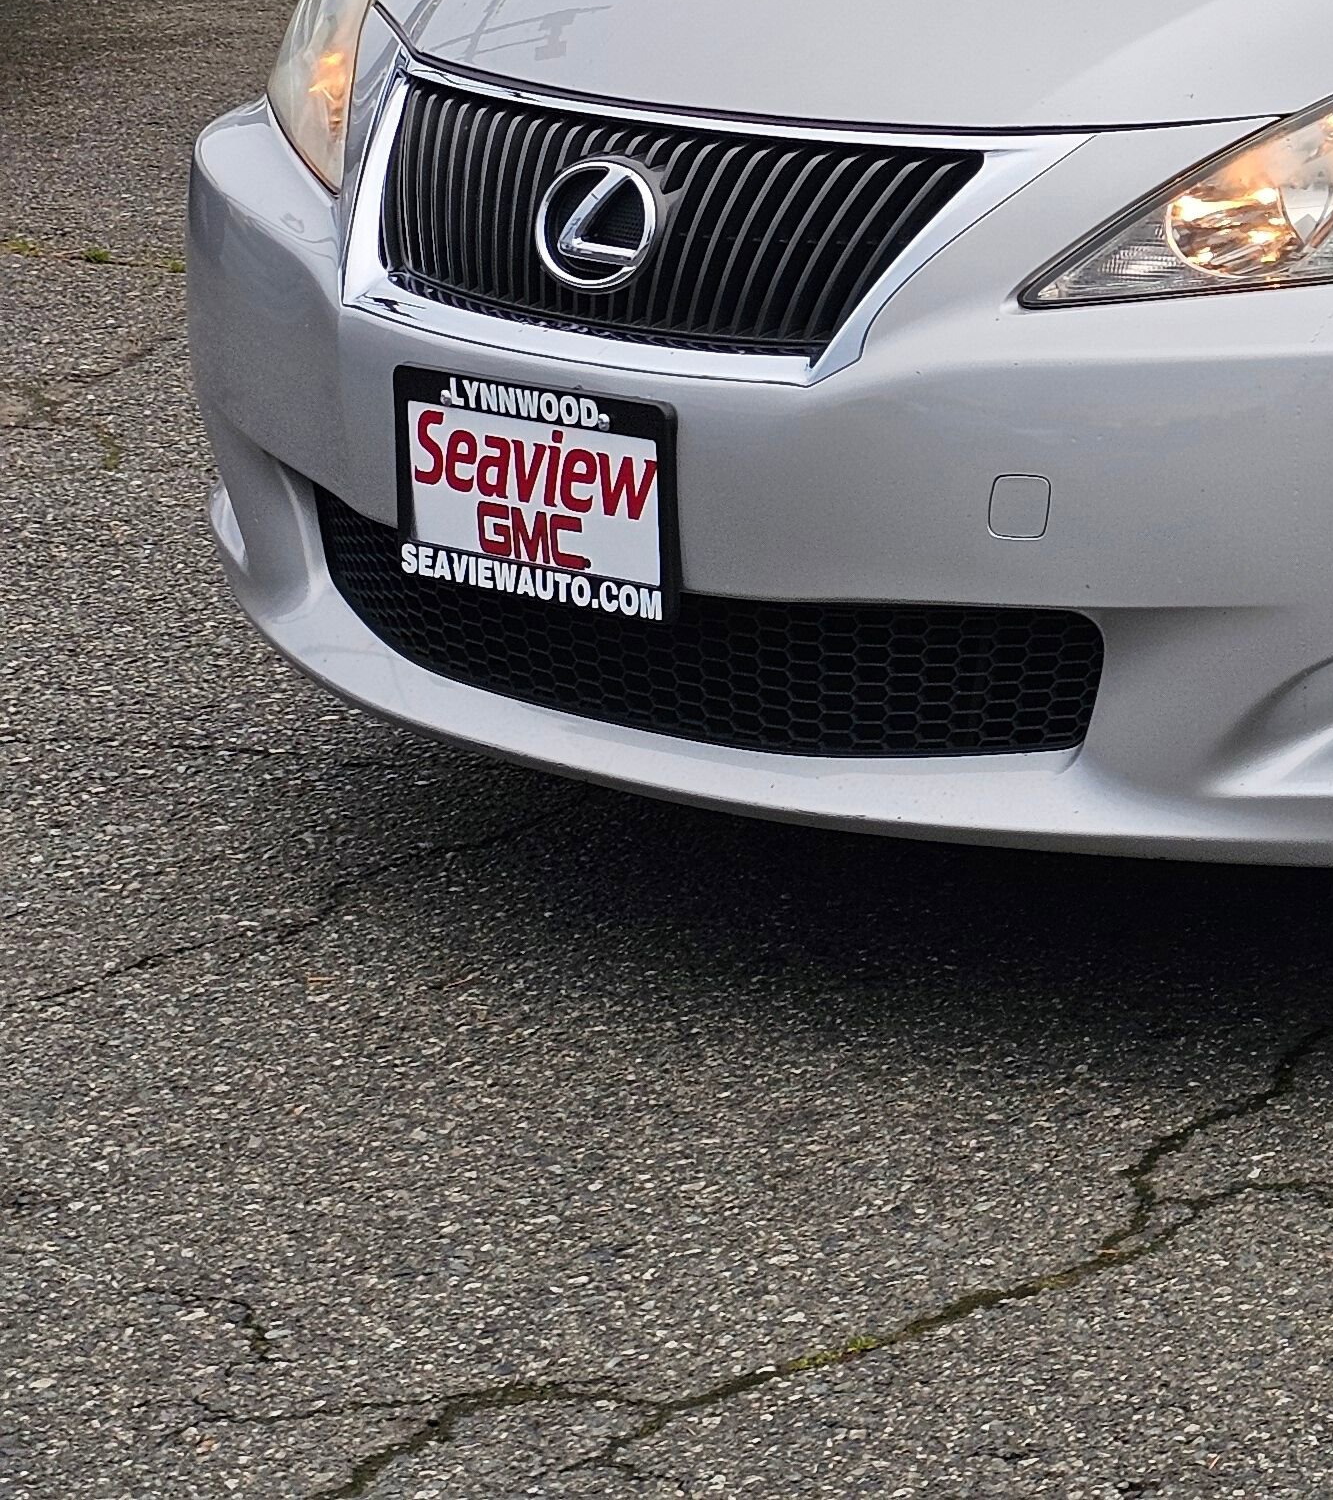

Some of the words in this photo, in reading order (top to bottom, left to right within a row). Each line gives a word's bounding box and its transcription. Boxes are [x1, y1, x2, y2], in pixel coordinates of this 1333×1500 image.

[448, 377, 600, 428] LYNNWOOD
[413, 408, 658, 522] Seaview
[476, 500, 592, 571] GMC
[401, 543, 663, 621] SEAVIEWAUTO.COM
